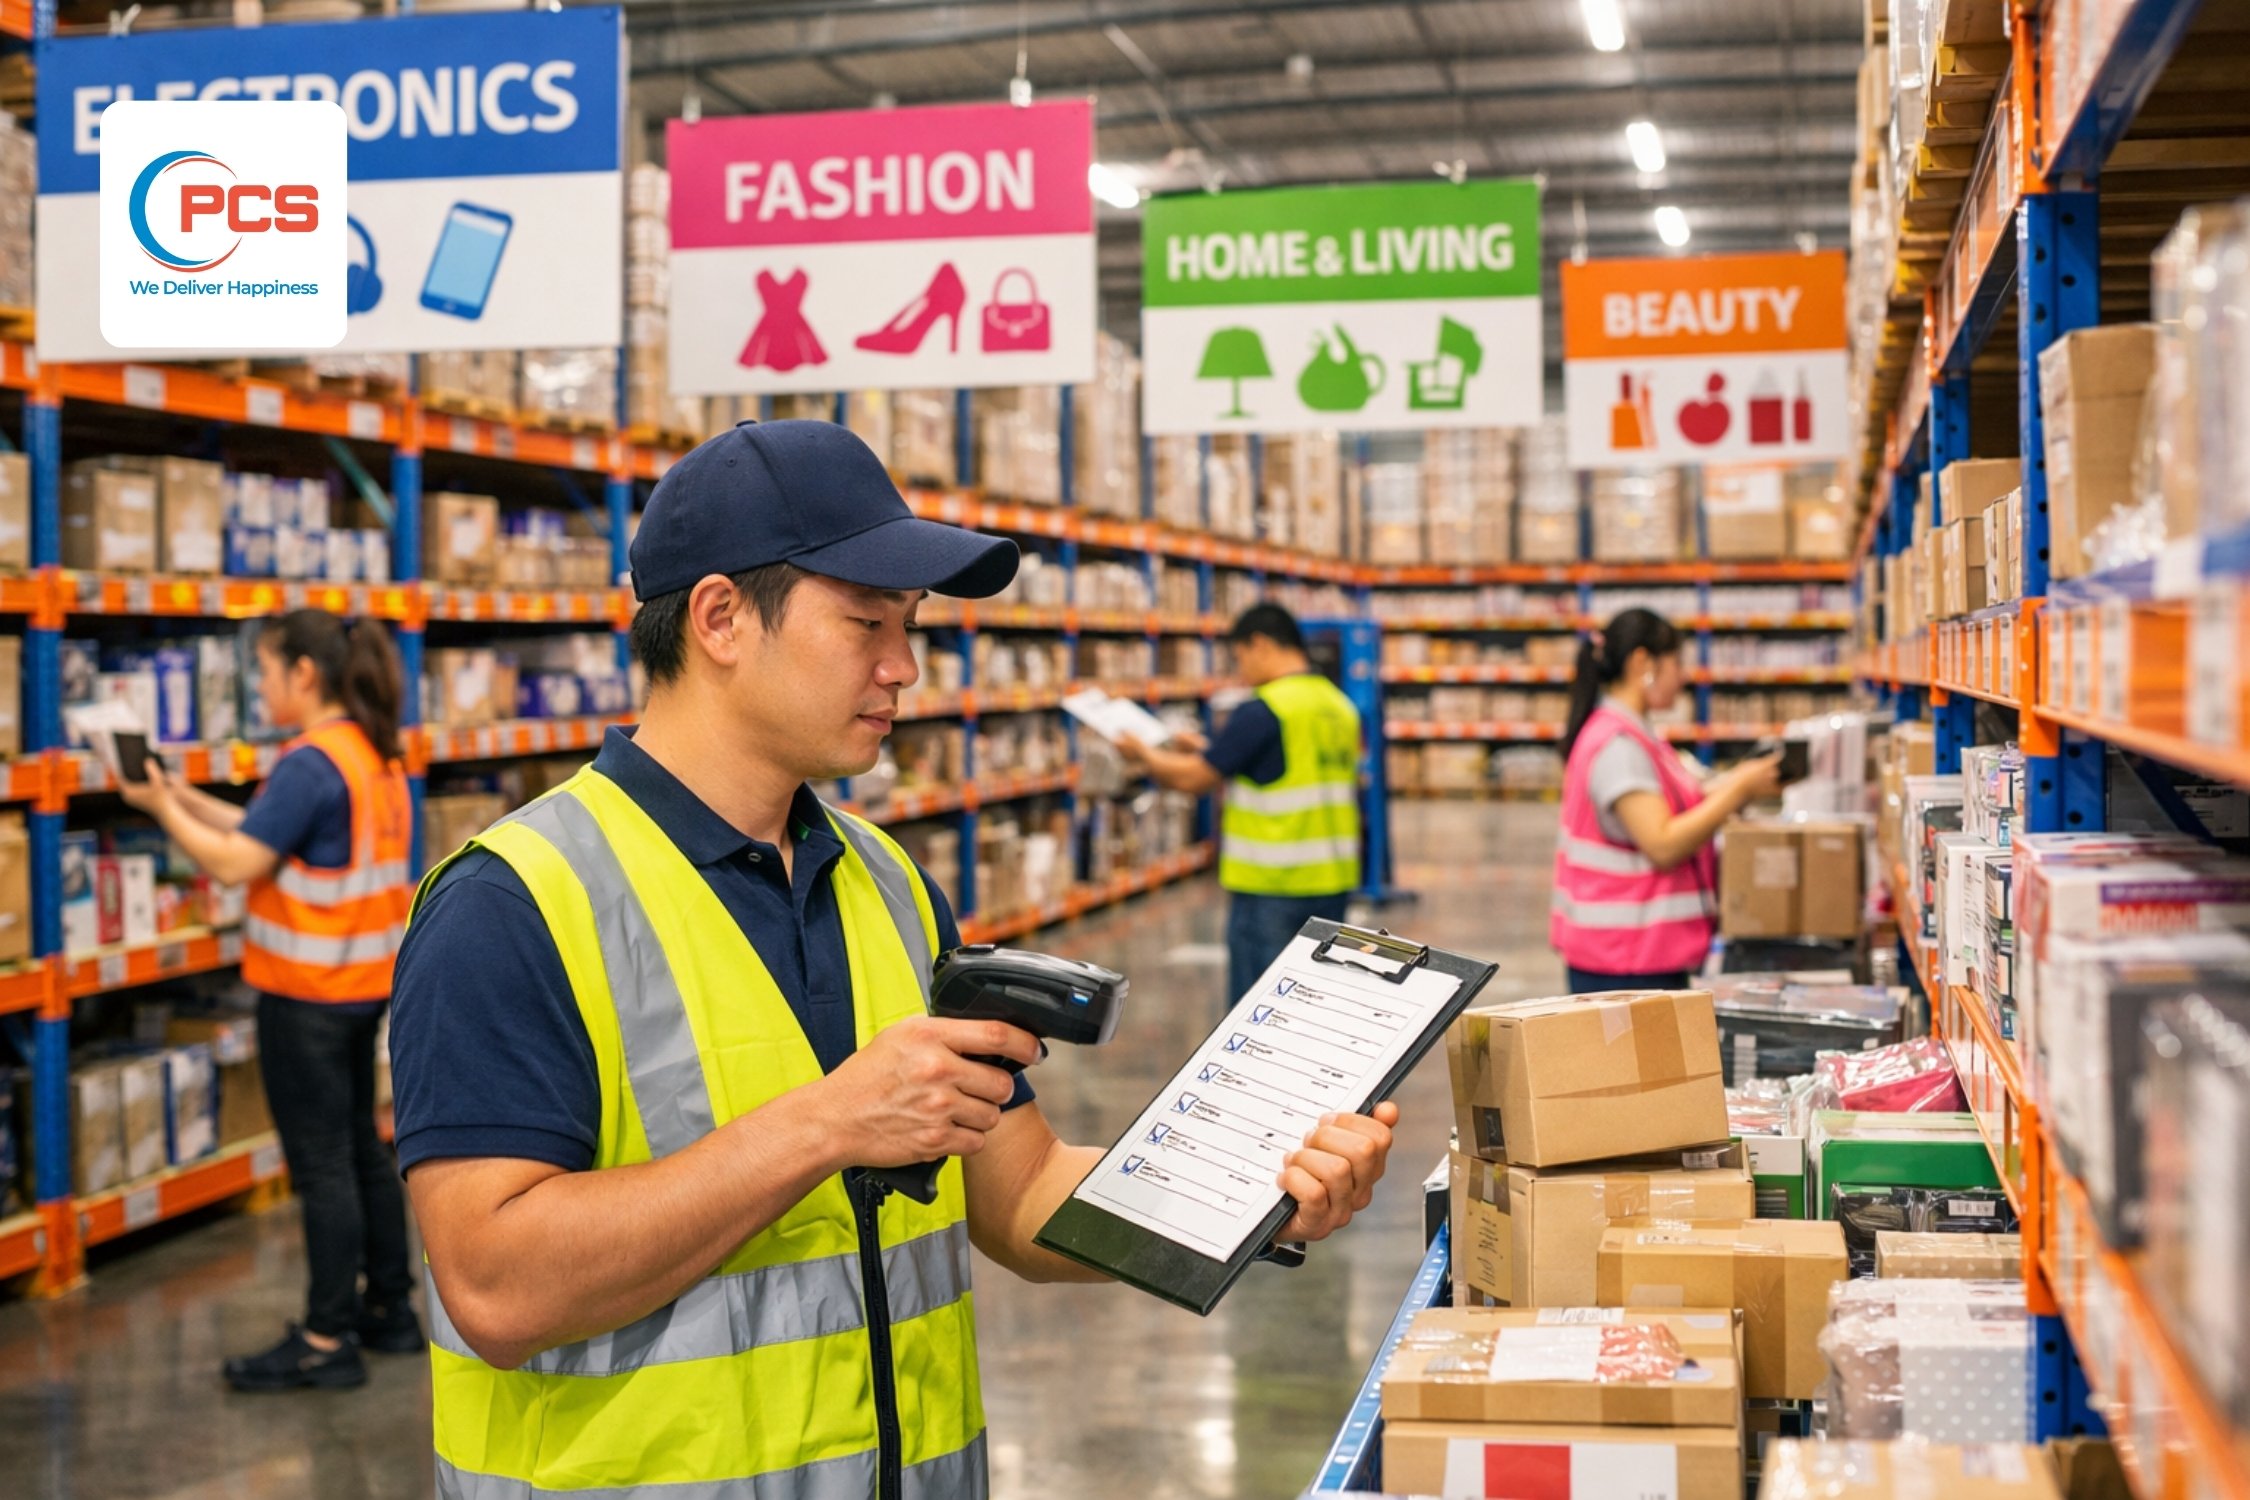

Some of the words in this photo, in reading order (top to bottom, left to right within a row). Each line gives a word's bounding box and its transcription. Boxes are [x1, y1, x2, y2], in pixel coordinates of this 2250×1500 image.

[74, 61, 578, 154] EONICS
[725, 149, 1035, 224] FASHION
[1167, 230, 1308, 281] HOME
[1314, 236, 1344, 277] &
[1351, 222, 1514, 275] LIVING
[1603, 287, 1801, 338] BEAUTY
